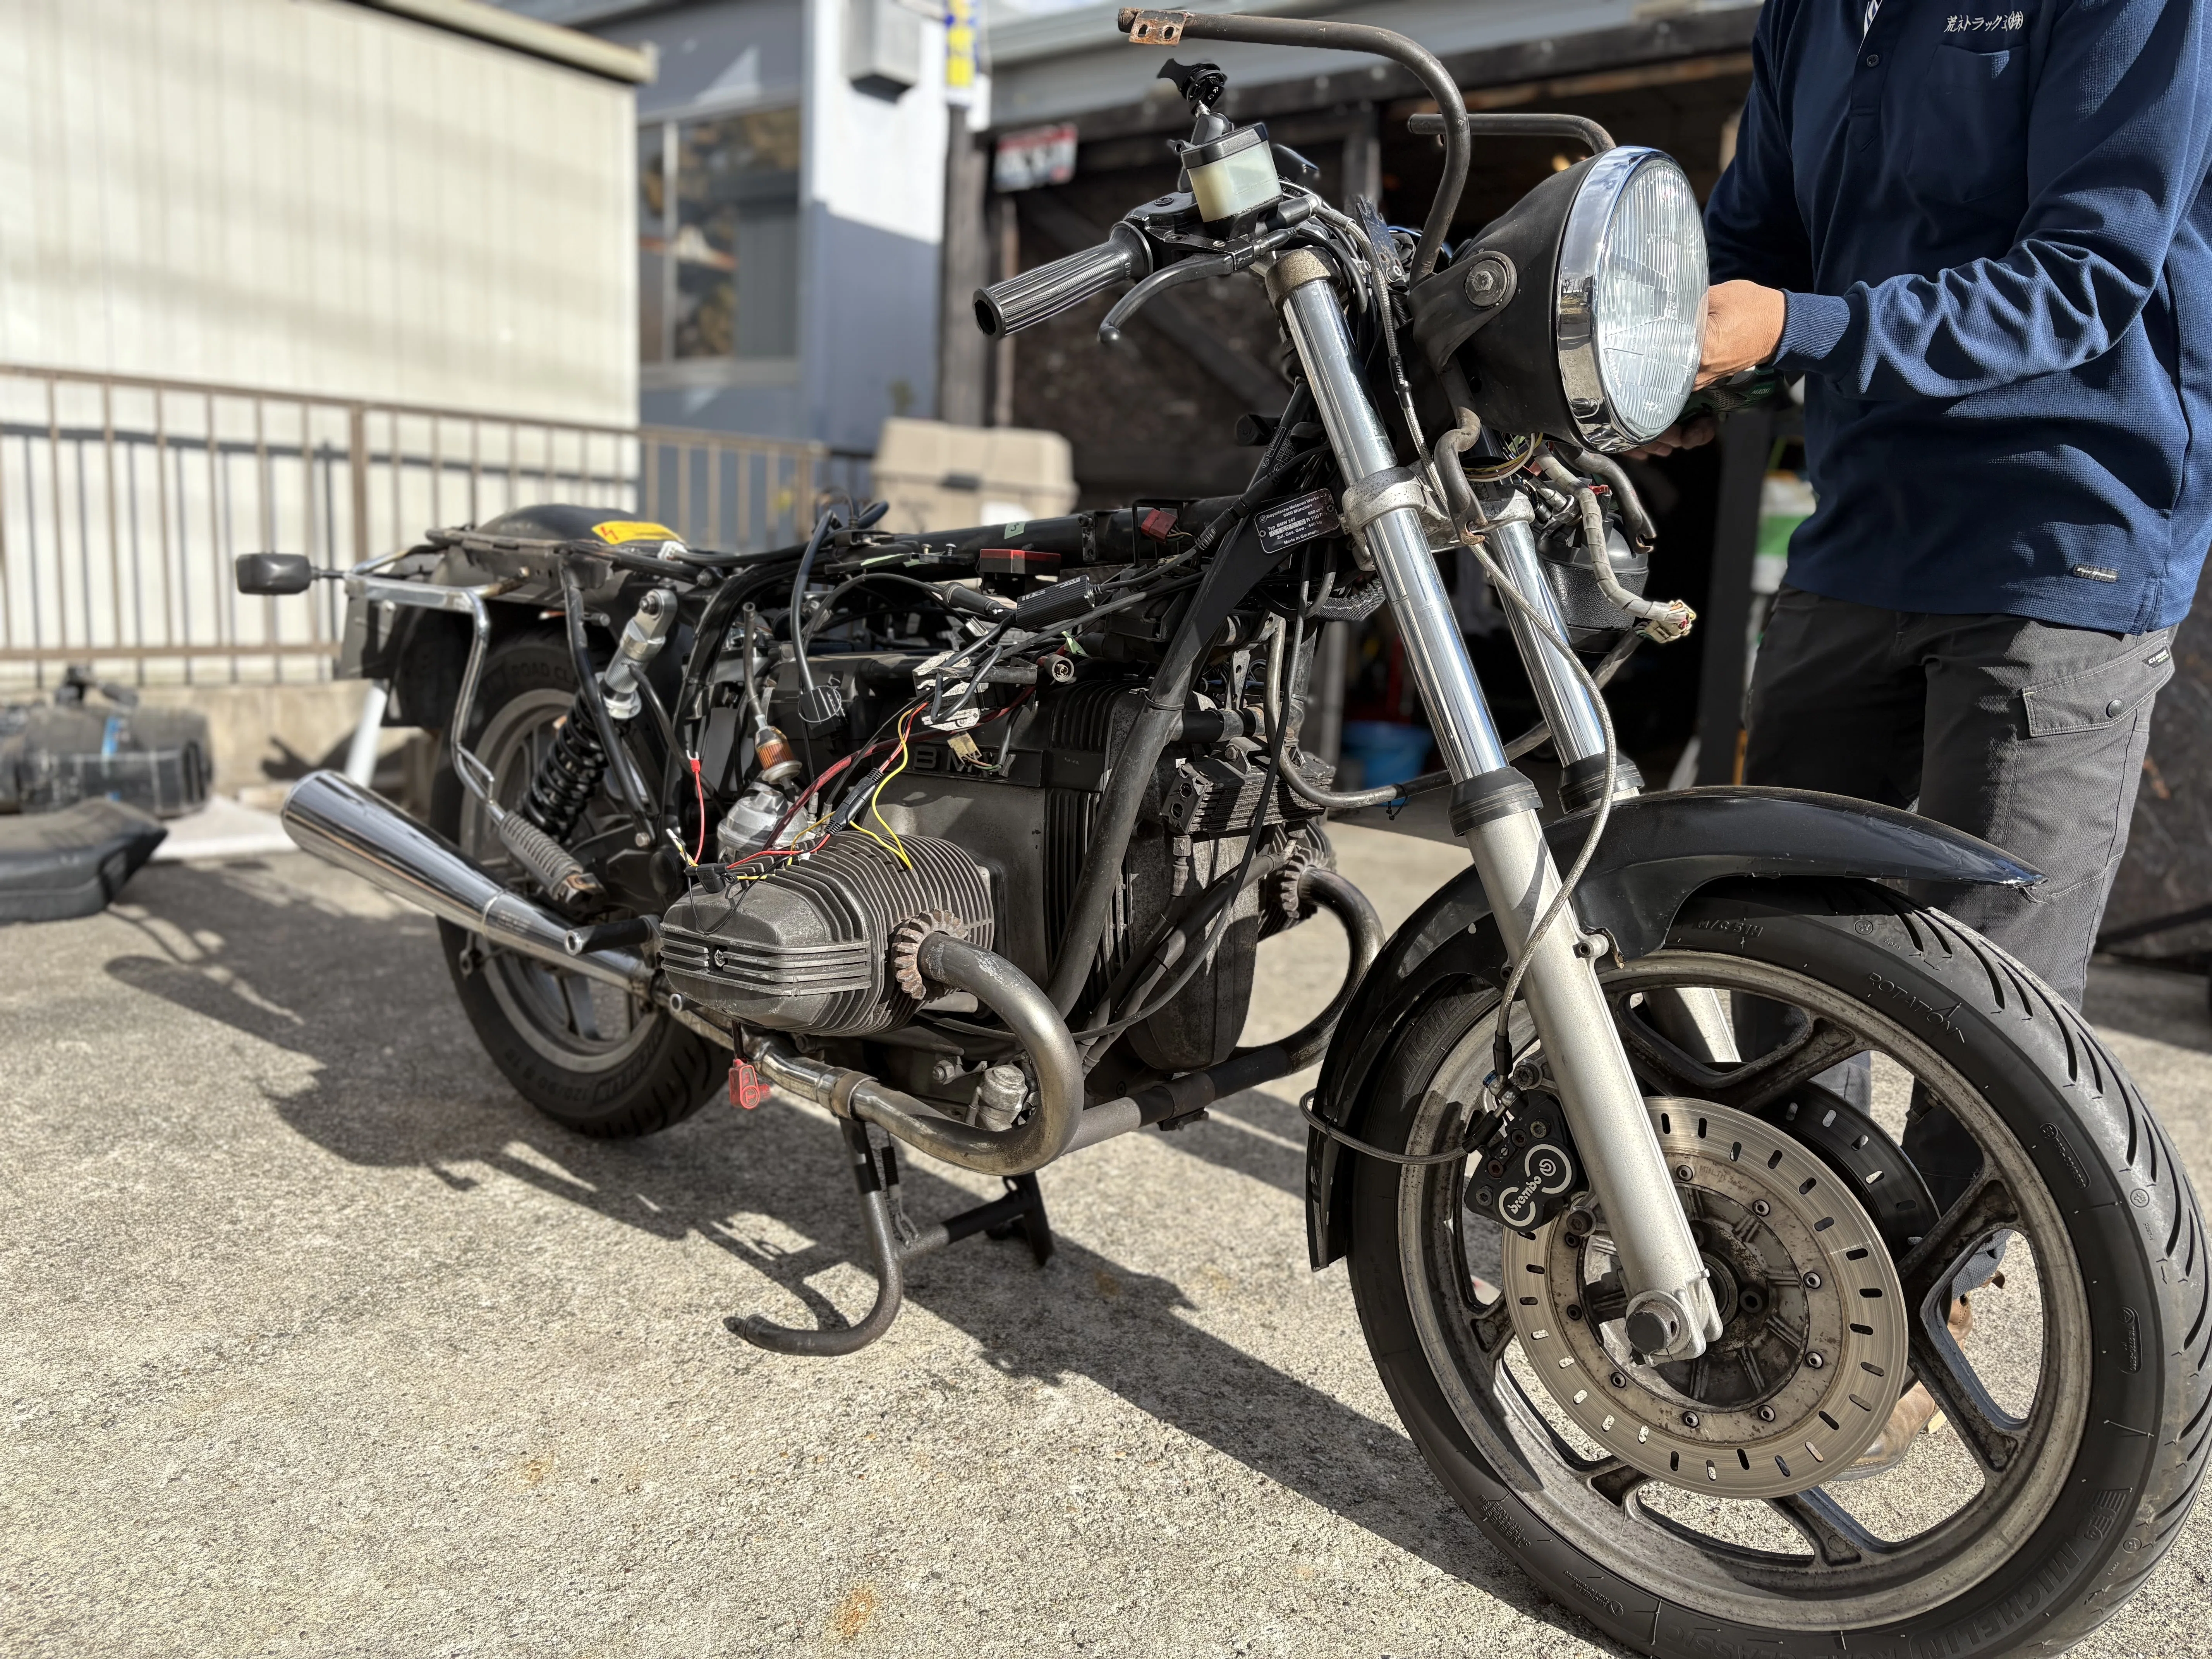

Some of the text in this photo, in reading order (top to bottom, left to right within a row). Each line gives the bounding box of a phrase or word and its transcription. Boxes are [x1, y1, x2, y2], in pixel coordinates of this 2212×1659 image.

[1266, 508, 1289, 519] Bayerische
[1289, 501, 1307, 510] Motoren
[1293, 504, 1313, 514] München
[1300, 529, 1319, 539] Germany
[1698, 920, 1729, 929] M/C
[1869, 972, 1965, 1043] ROTATION
[1507, 1176, 1542, 1214] brembo
[1490, 1506, 1505, 1523] TYPE
[1493, 1501, 1509, 1519] TUBE
[1481, 1504, 1521, 1548] TUBELESS
[1505, 1521, 1521, 1539] TUBE
[1522, 1537, 1531, 1547] ON
[1575, 1583, 1607, 1607] MICHELIN
[1919, 1541, 2081, 1659] MICHELIN
